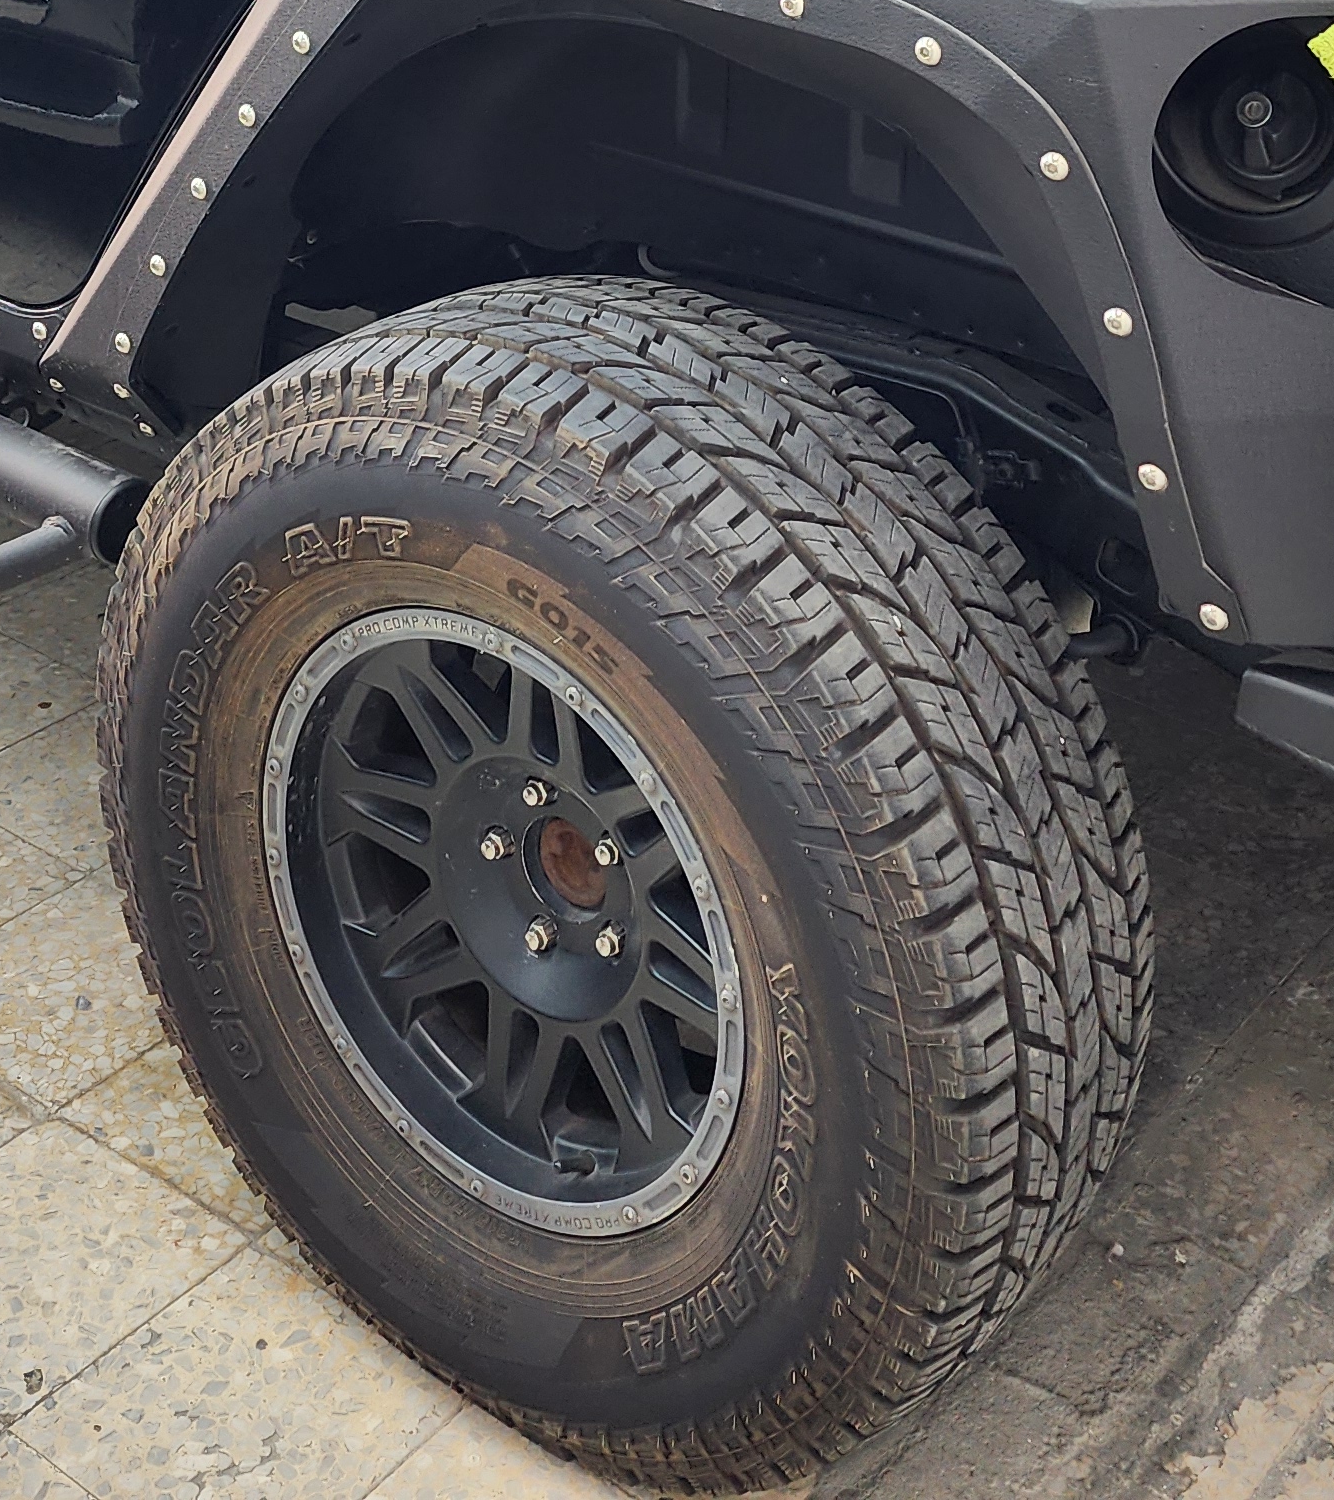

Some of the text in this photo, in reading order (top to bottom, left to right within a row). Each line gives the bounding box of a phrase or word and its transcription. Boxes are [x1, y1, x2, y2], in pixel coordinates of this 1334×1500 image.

[281, 515, 412, 578] A/T
[357, 614, 480, 639] PRO COMP XTREME
[622, 962, 816, 1376] YOKOHAMA
[554, 1214, 593, 1231] COMP
[595, 1215, 621, 1230] PRO
